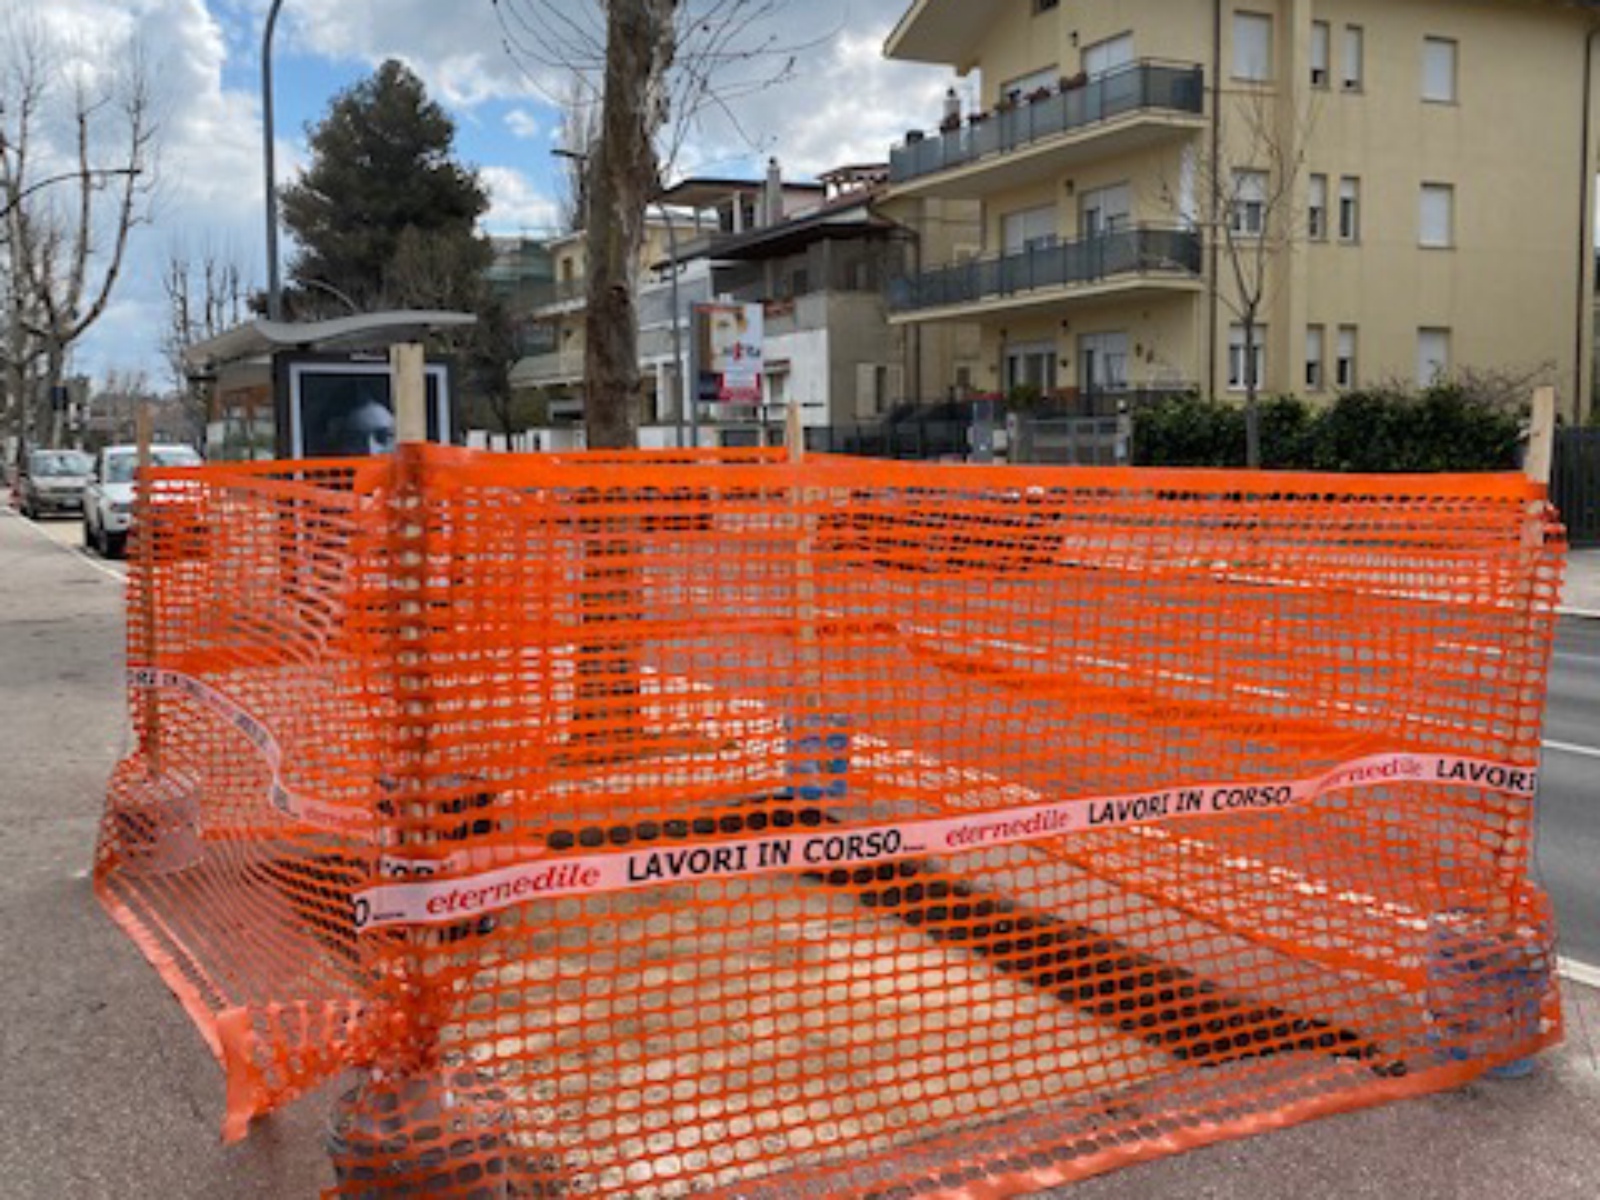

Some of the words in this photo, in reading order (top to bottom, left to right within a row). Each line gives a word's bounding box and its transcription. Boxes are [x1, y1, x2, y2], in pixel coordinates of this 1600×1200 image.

[426, 864, 601, 915] eternedile
[627, 845, 747, 881] LAVORI
[756, 839, 792, 867] IN
[1088, 793, 1170, 824] LAVORI
[1175, 789, 1204, 811] IN
[1211, 786, 1292, 811] CORSO
